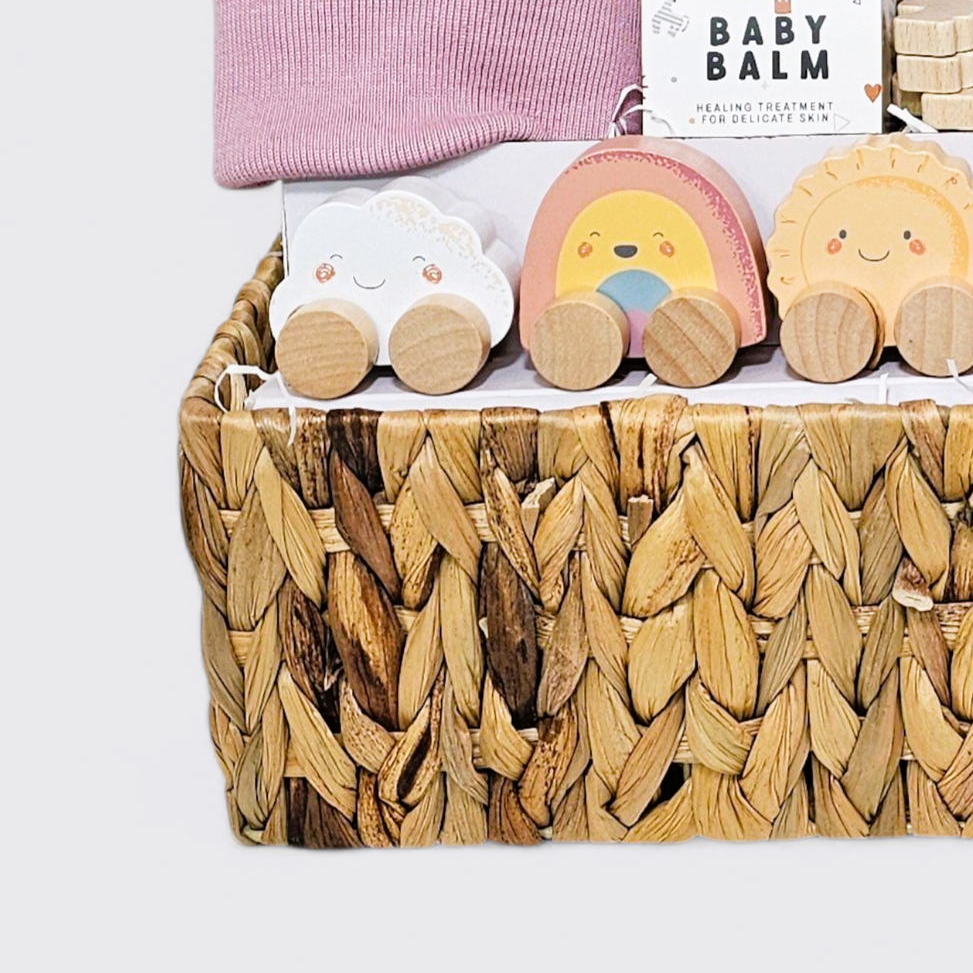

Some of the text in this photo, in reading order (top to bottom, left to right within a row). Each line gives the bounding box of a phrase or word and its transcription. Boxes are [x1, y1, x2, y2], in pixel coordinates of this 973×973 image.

[710, 15, 827, 46] BABY
[706, 49, 829, 80] BALM
[697, 101, 834, 113] HEALING TREATMENT
[701, 113, 829, 124] FOR DELICATE SKIN
